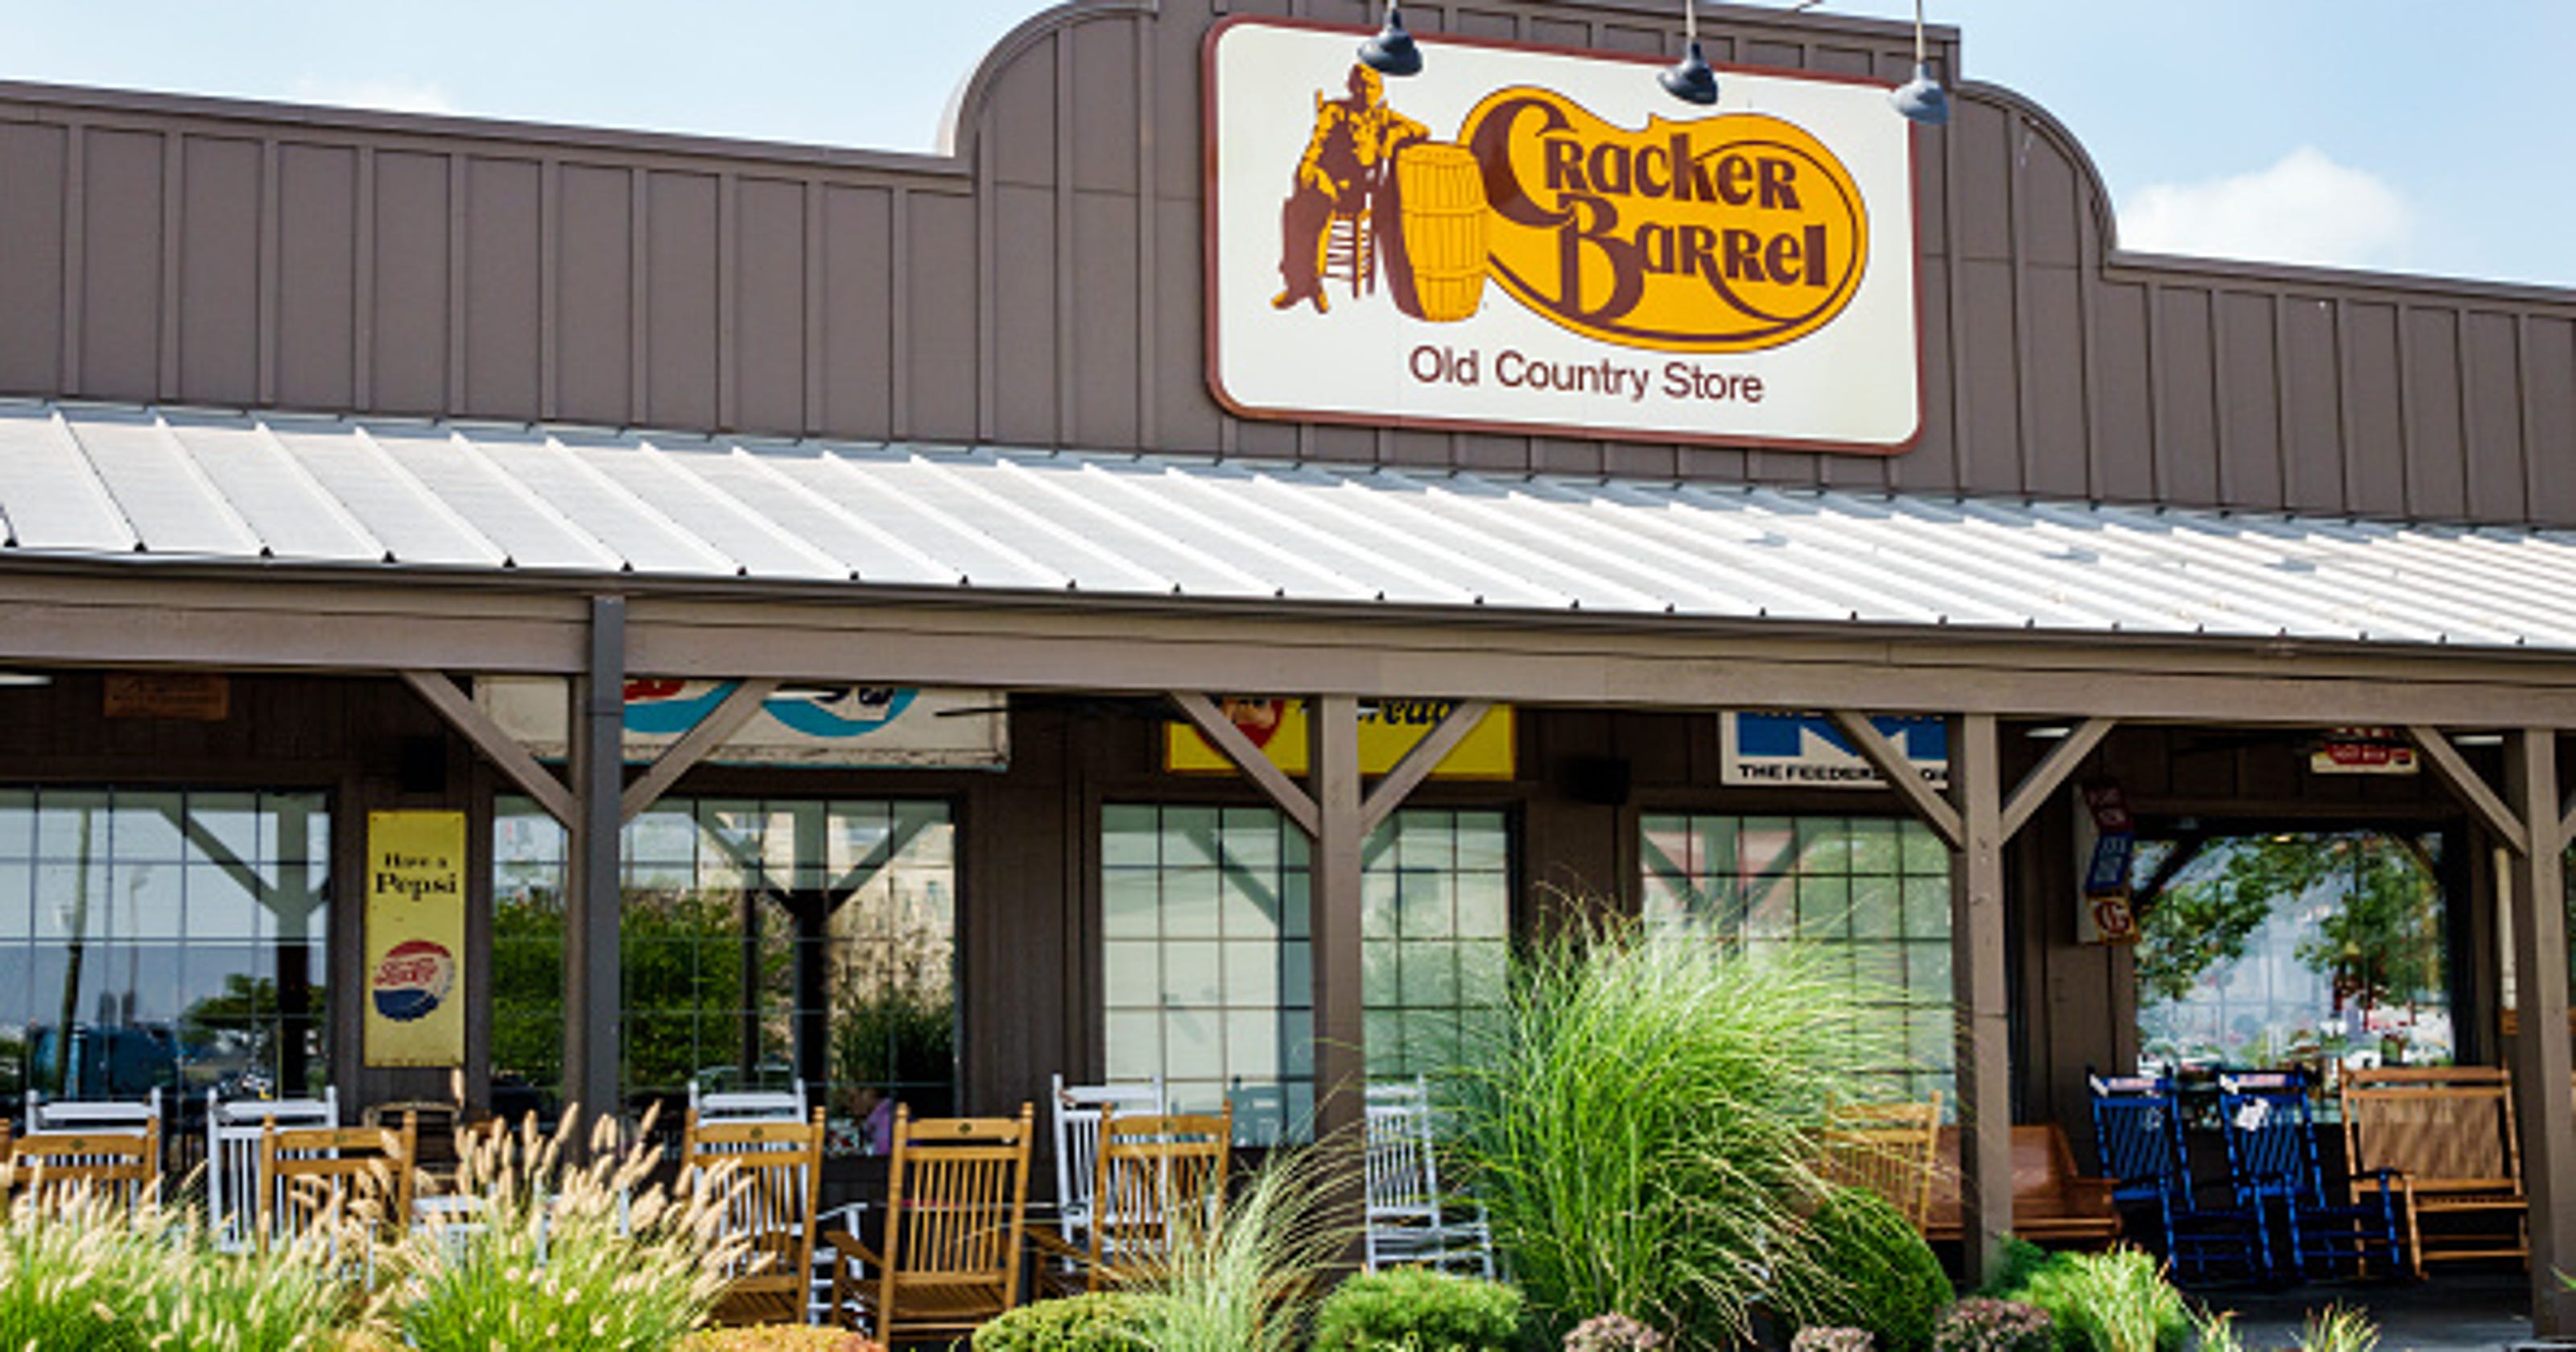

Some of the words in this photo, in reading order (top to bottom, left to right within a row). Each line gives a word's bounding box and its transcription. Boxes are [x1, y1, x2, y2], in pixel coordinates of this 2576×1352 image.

[1409, 344, 1480, 386] Old
[1494, 349, 1649, 402] Country
[1662, 361, 1765, 403] Store
[1738, 764, 1783, 781] THE
[376, 872, 456, 902] Pepsi
